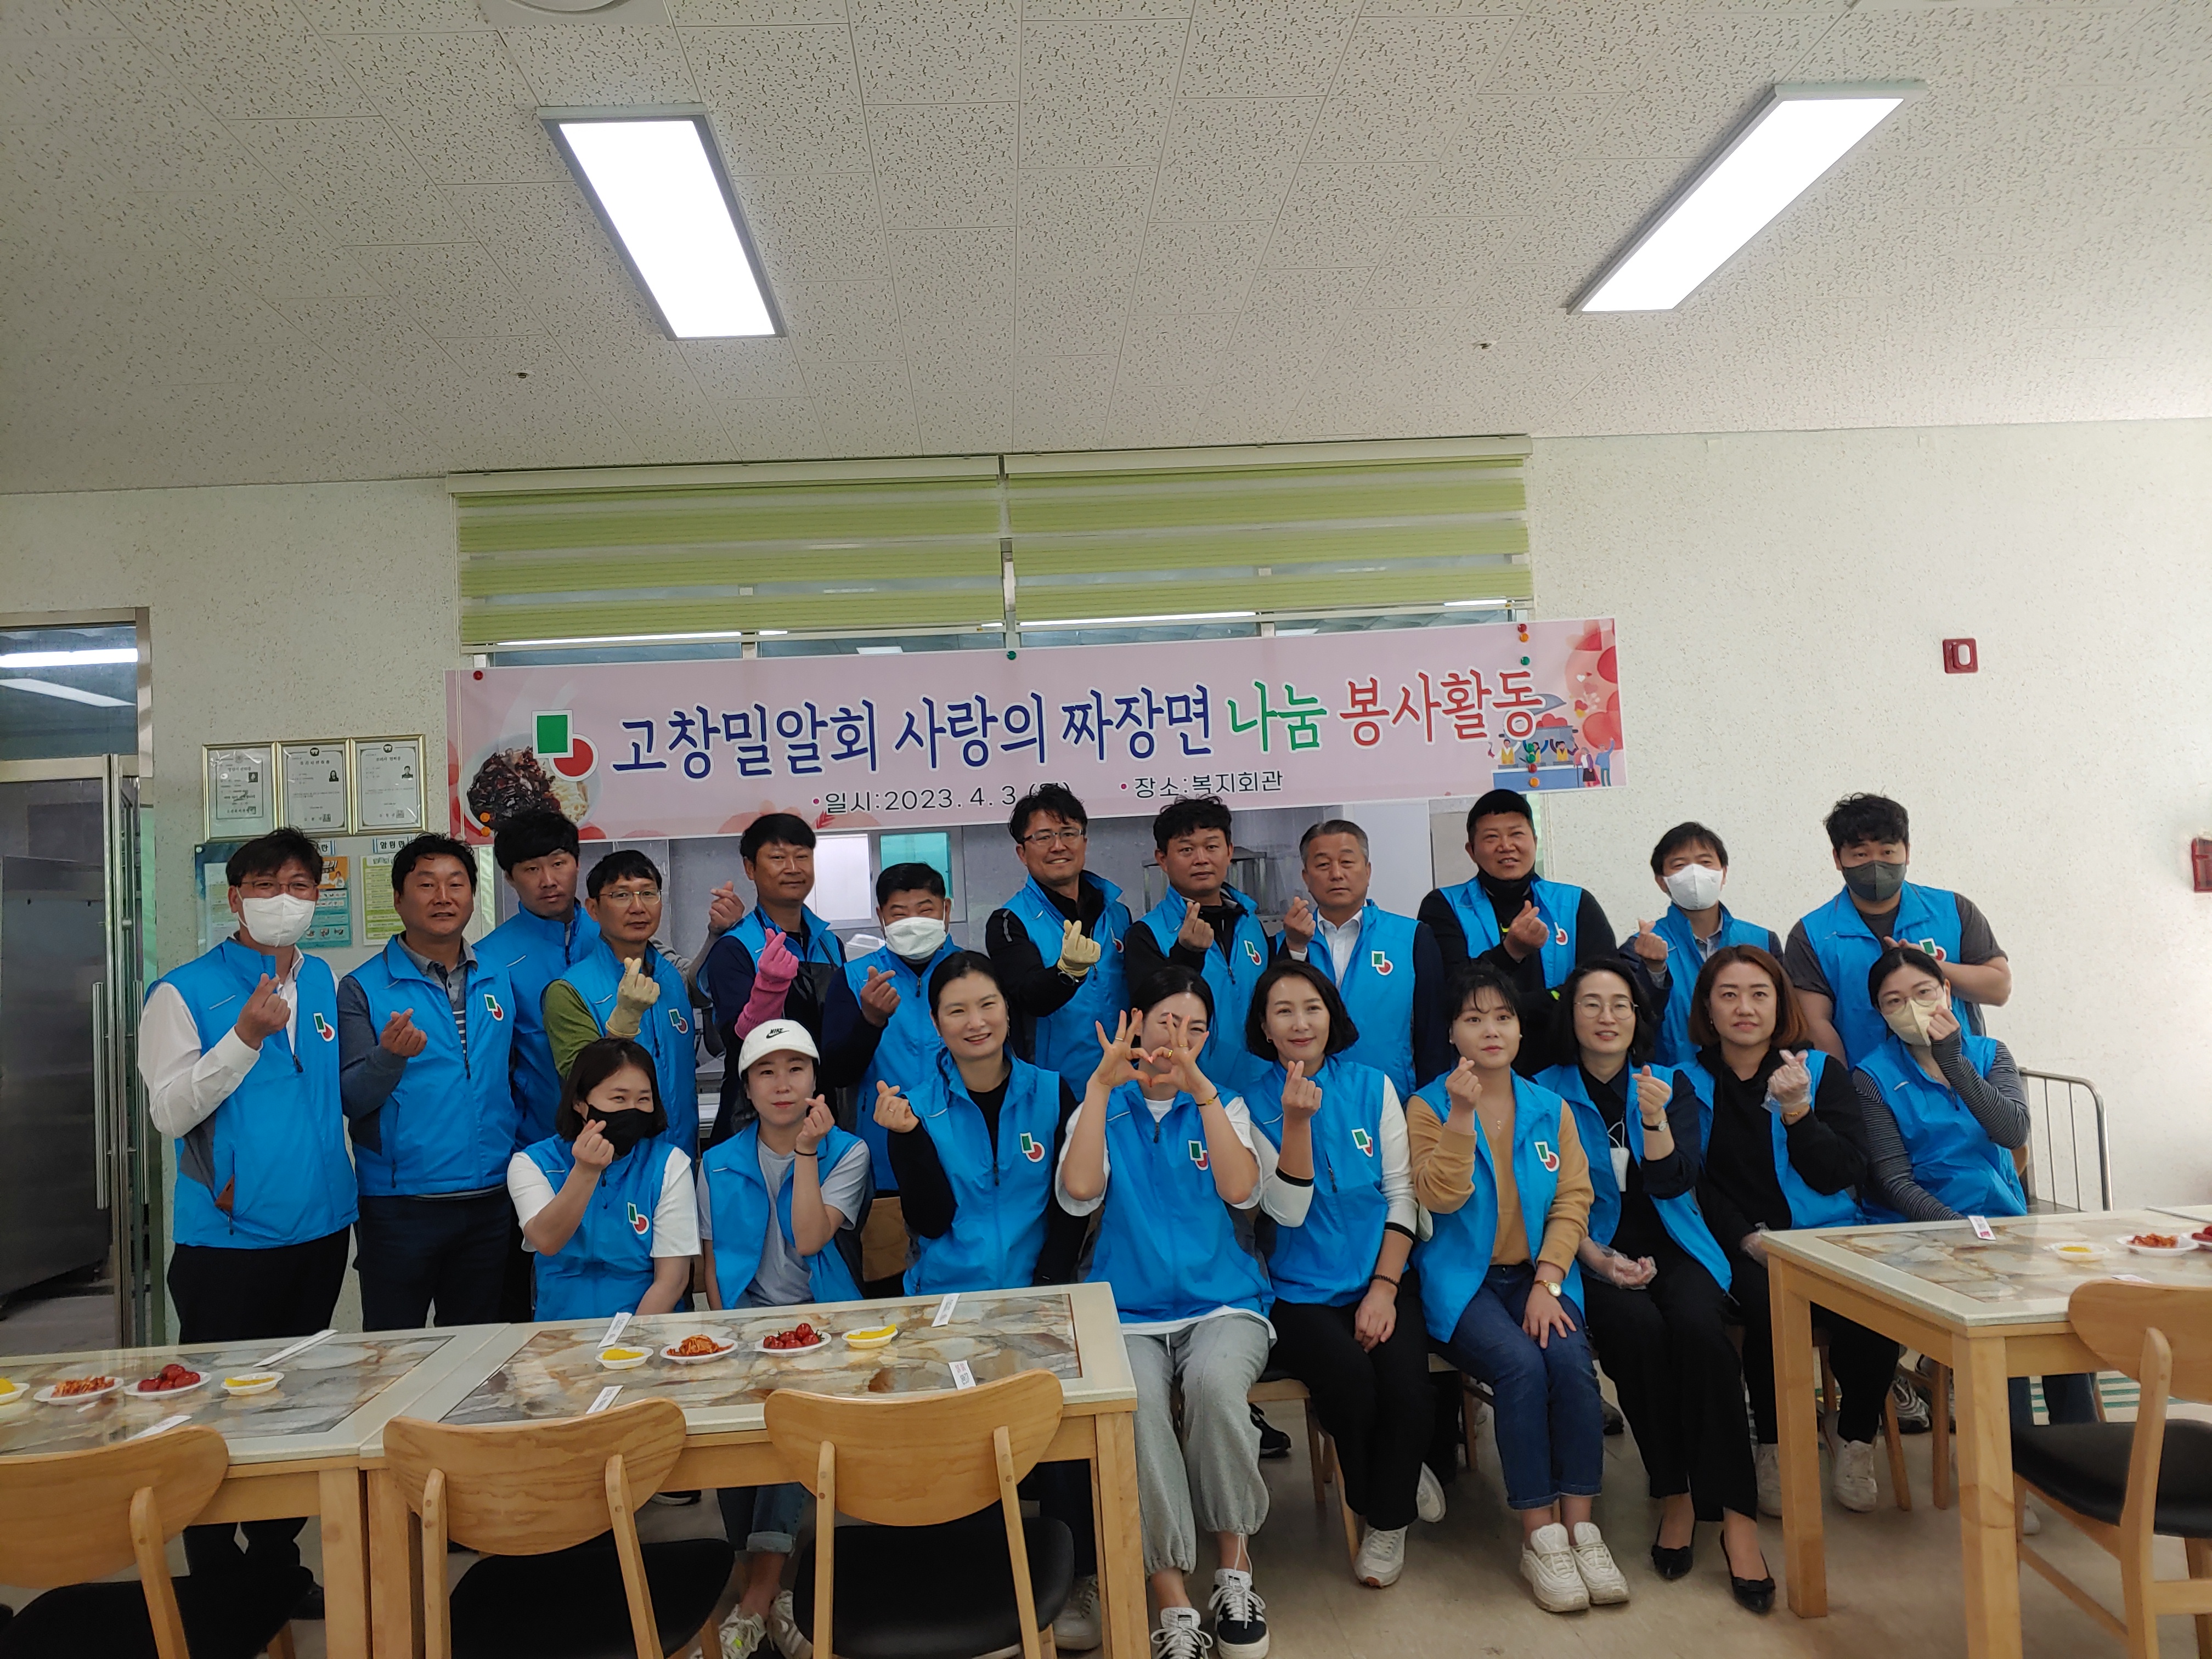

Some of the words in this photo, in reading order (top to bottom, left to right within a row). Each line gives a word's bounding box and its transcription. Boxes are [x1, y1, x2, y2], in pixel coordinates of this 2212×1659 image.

[612, 699, 877, 779] 고창밀알회
[895, 692, 1046, 769] 사랑의
[1062, 684, 1211, 760] 짜장면
[1227, 681, 1327, 752] 나눔
[1339, 669, 1543, 746] 봉사활동
[1001, 786, 1017, 805] 3
[1134, 770, 1283, 798] 장소:복지회관
